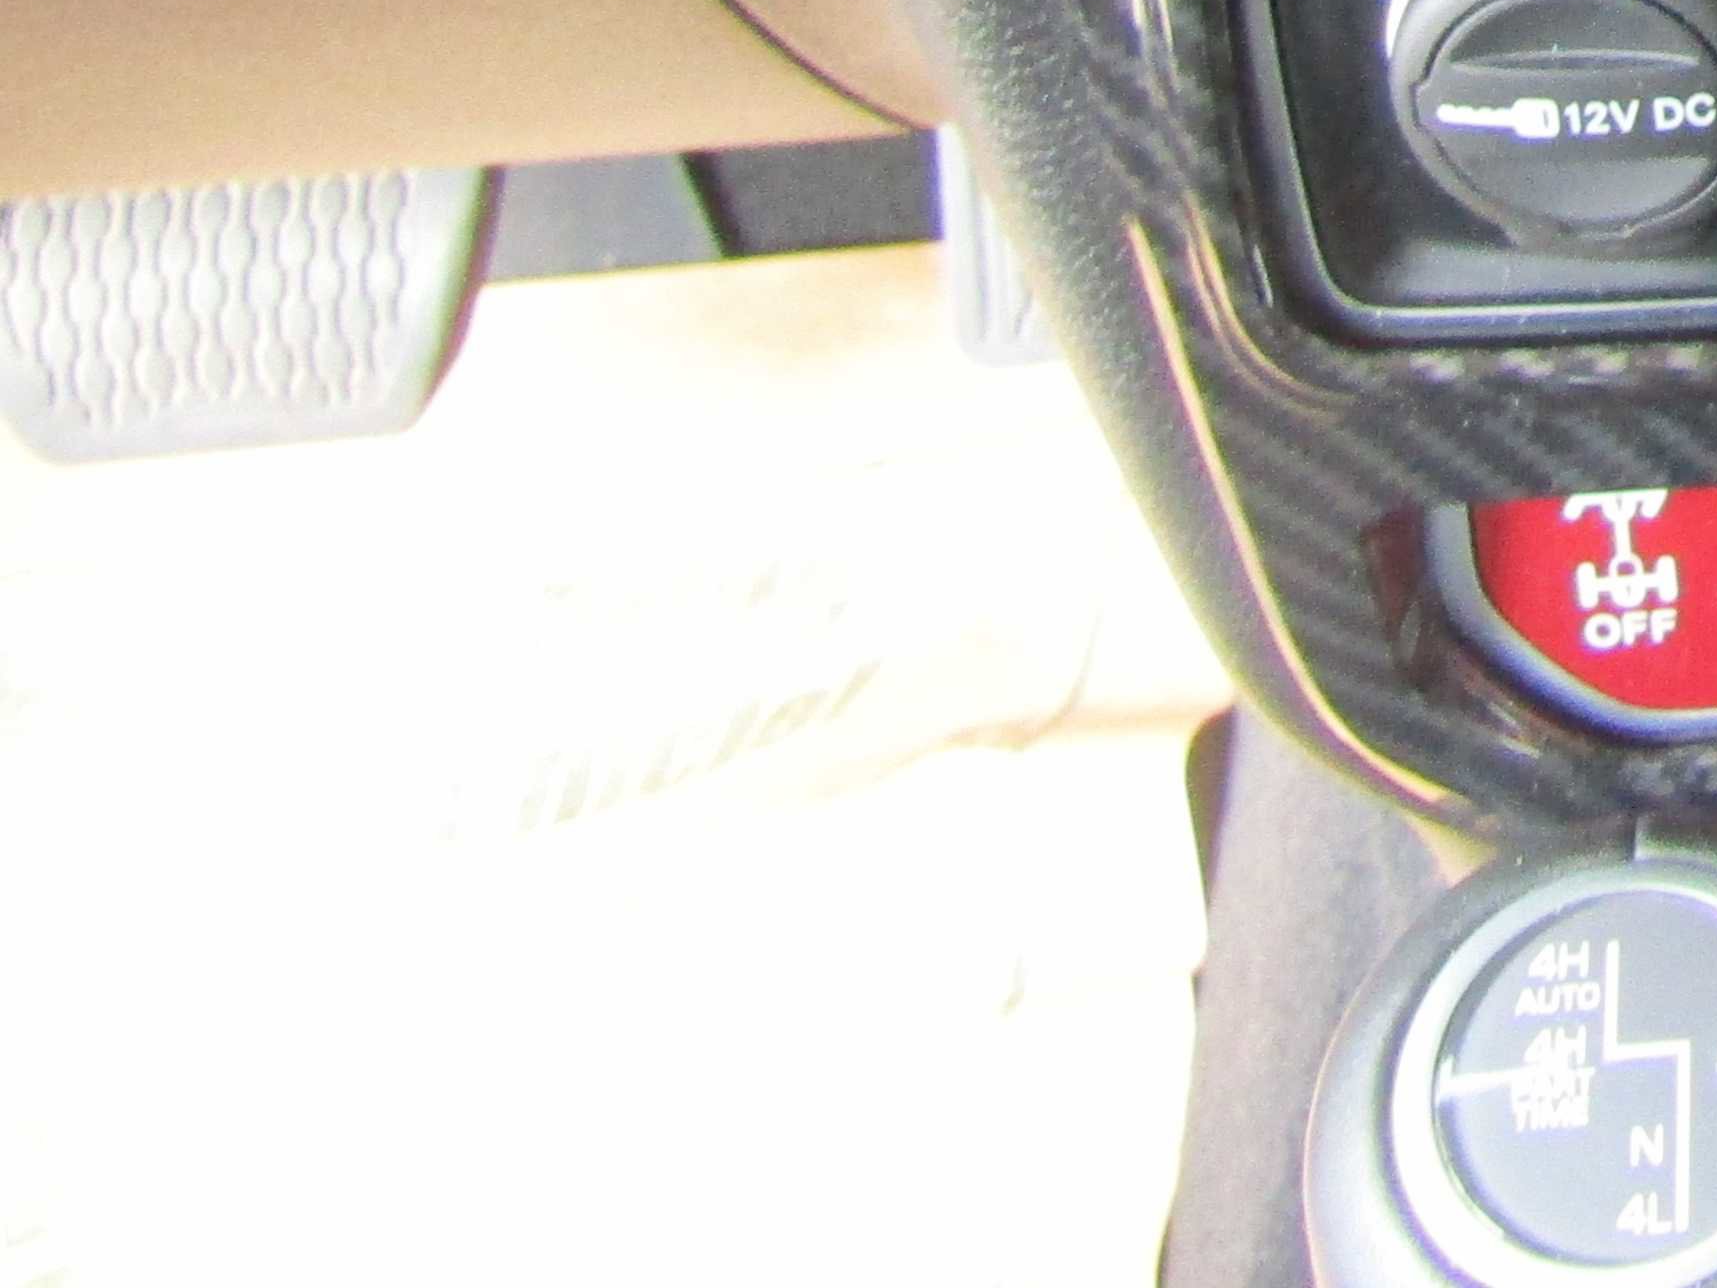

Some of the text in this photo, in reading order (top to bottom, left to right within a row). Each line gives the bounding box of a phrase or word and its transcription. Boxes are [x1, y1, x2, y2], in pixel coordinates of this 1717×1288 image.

[1564, 93, 1717, 136] 12V DC
[1582, 607, 1677, 651] OFF
[1526, 940, 1591, 981] 4H
[1514, 980, 1601, 1017] AUTO
[1522, 1025, 1588, 1067] 4H
[1629, 1124, 1665, 1168] N
[1616, 1192, 1675, 1235] 4L
